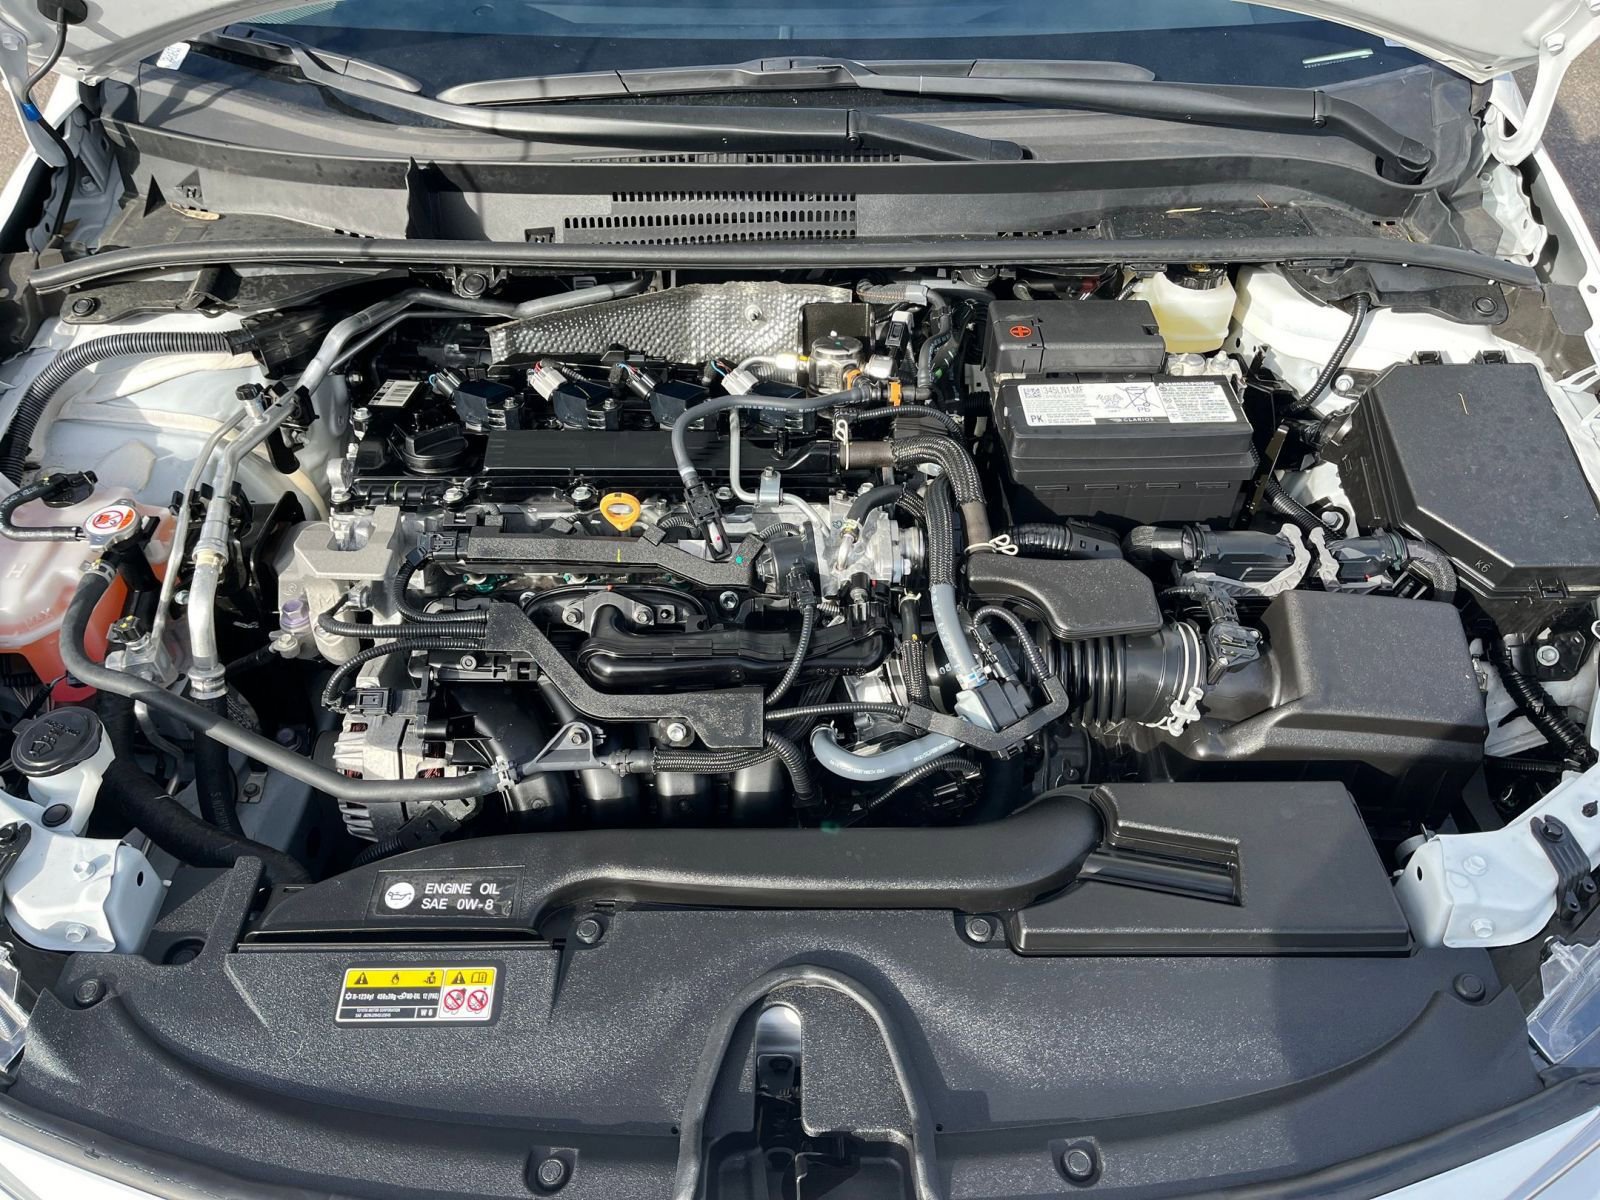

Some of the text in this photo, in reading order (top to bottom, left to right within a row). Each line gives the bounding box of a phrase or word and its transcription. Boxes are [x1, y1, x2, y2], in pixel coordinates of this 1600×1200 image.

[1030, 415, 1043, 423] PK
[425, 883, 500, 895] ENGINE OIL
[421, 898, 494, 910] SAE 0W-8
